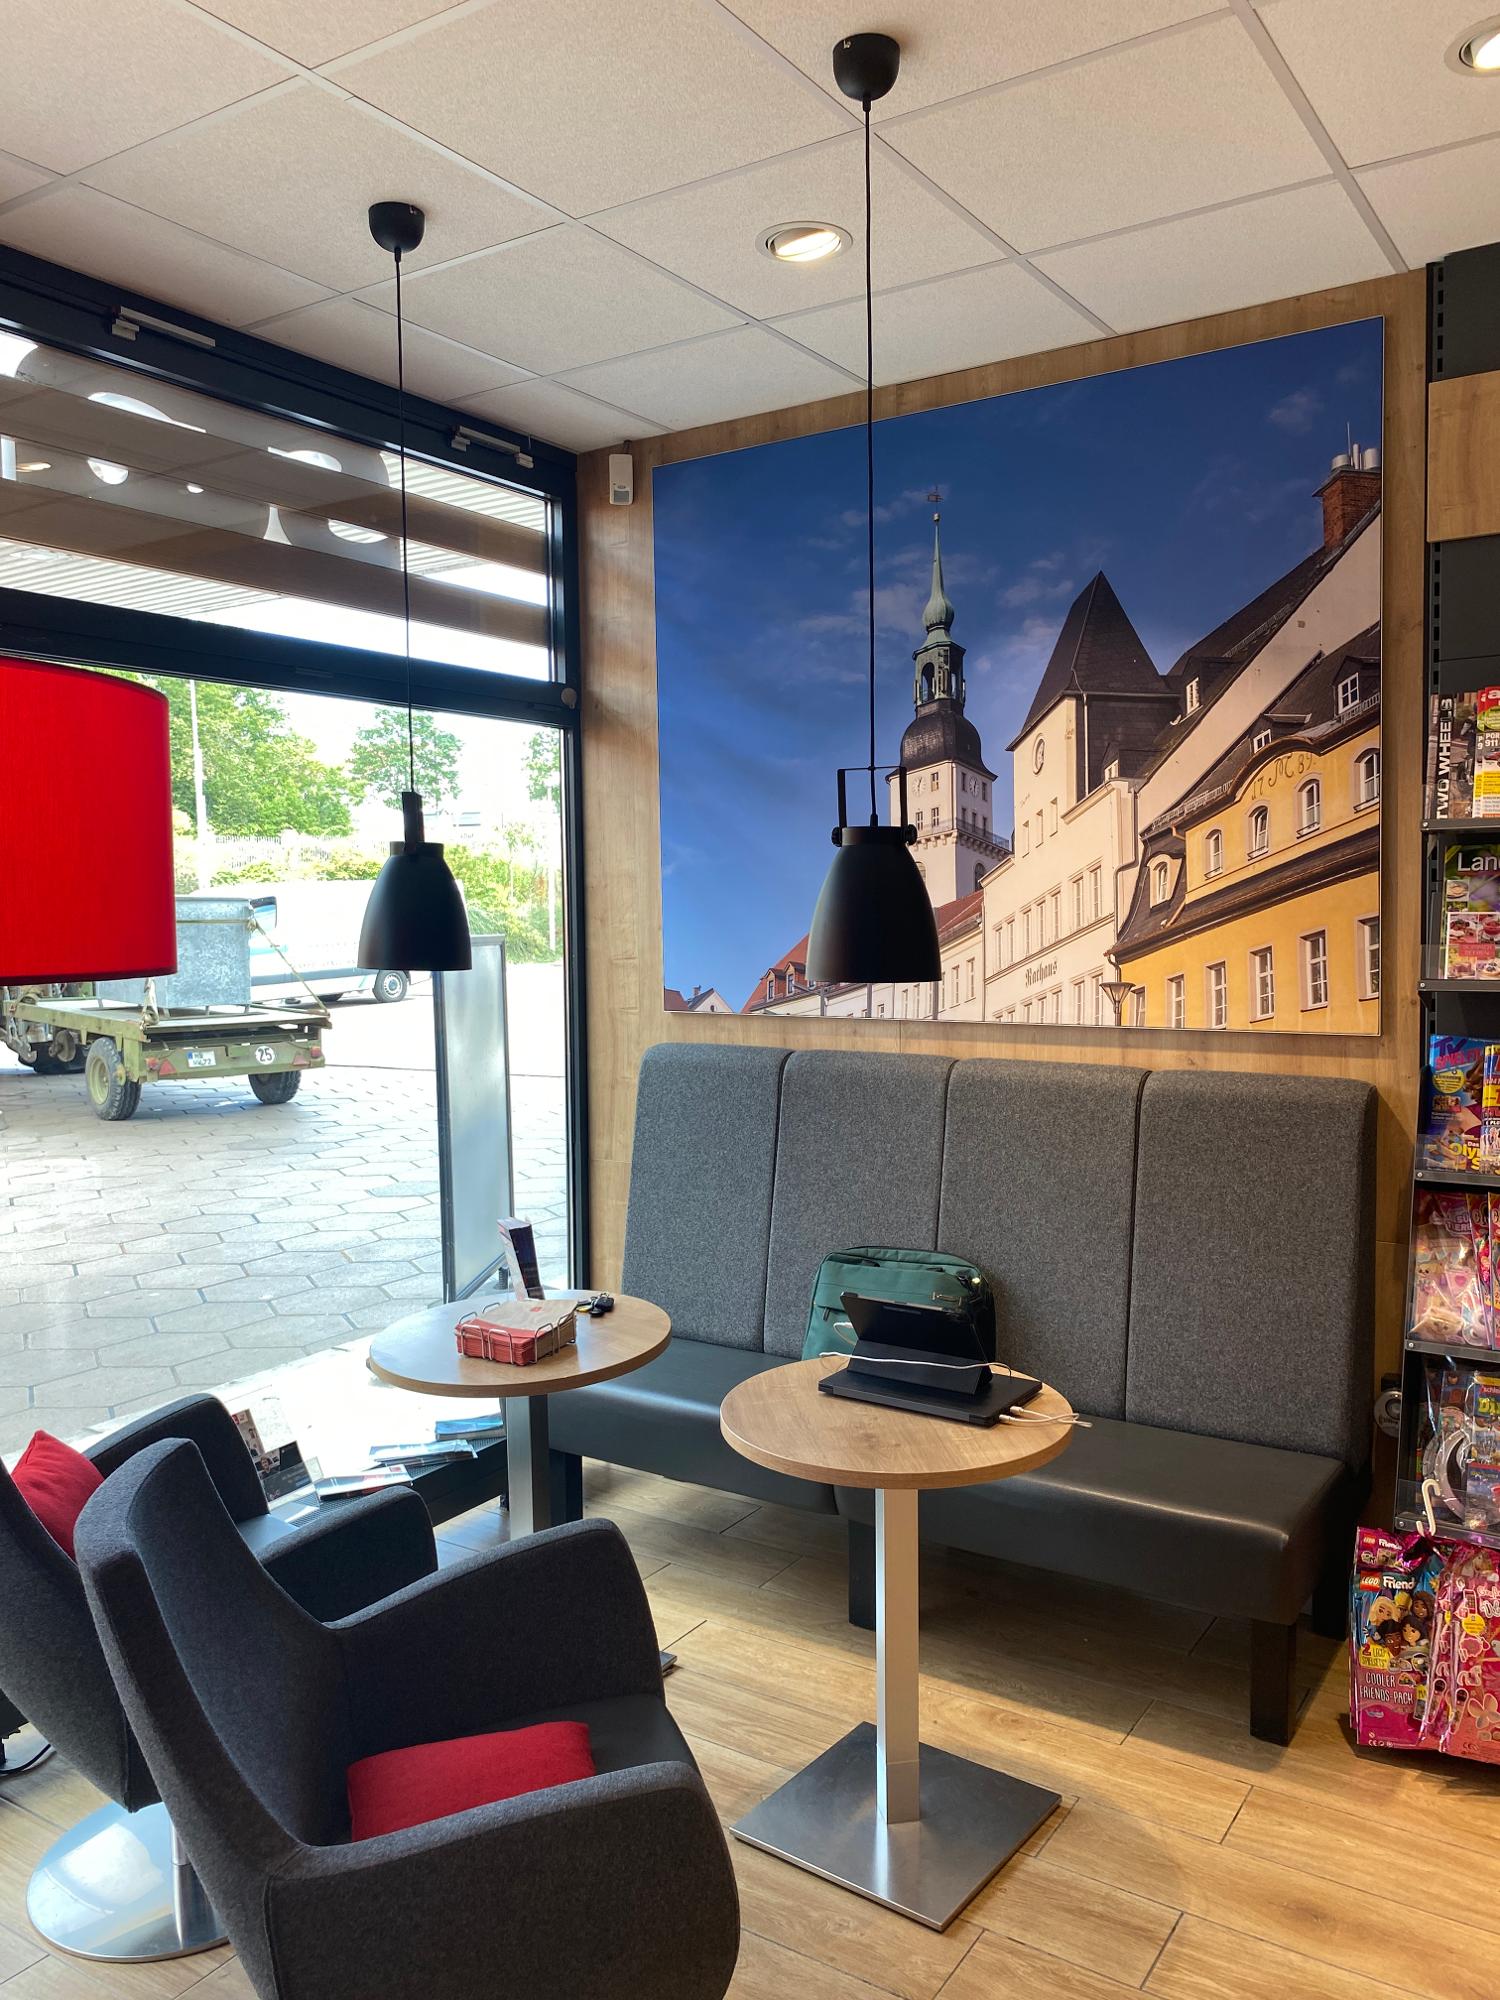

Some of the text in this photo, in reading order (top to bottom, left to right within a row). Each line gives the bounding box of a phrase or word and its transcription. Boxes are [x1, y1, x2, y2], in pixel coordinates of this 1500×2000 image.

[1437, 698, 1453, 819] TWO WHEELS
[1457, 852, 1500, 872] Lan
[258, 1047, 273, 1062] 25
[1361, 1576, 1379, 1586] LEGO
[1362, 1643, 1372, 1657] 2
[1365, 1671, 1396, 1688] COOLER
